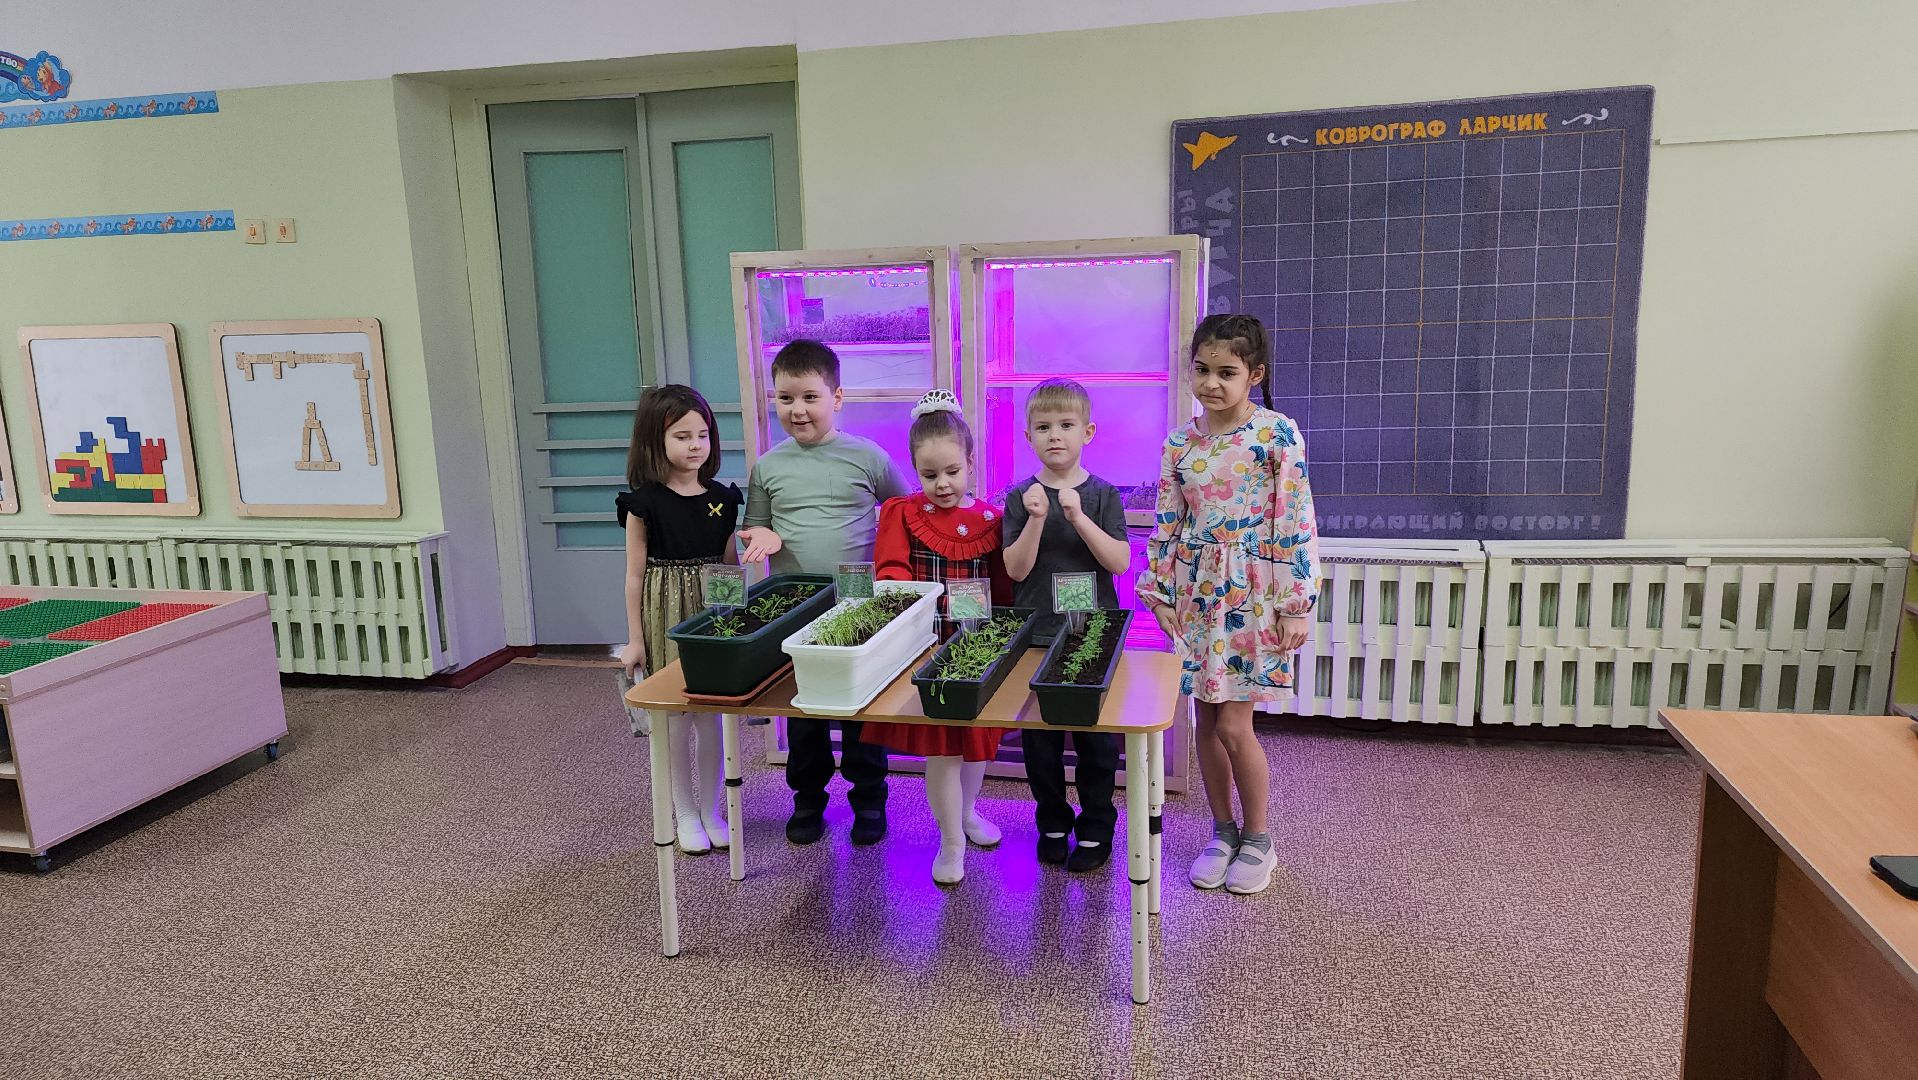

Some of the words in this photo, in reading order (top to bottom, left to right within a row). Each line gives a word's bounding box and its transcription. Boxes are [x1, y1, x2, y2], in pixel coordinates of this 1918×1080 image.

[0, 56, 18, 68] ТВО
[1315, 119, 1447, 146] КОВРОГРАФ
[1458, 112, 1549, 136] ЛАРЧИК
[1177, 188, 1198, 231] РЫ
